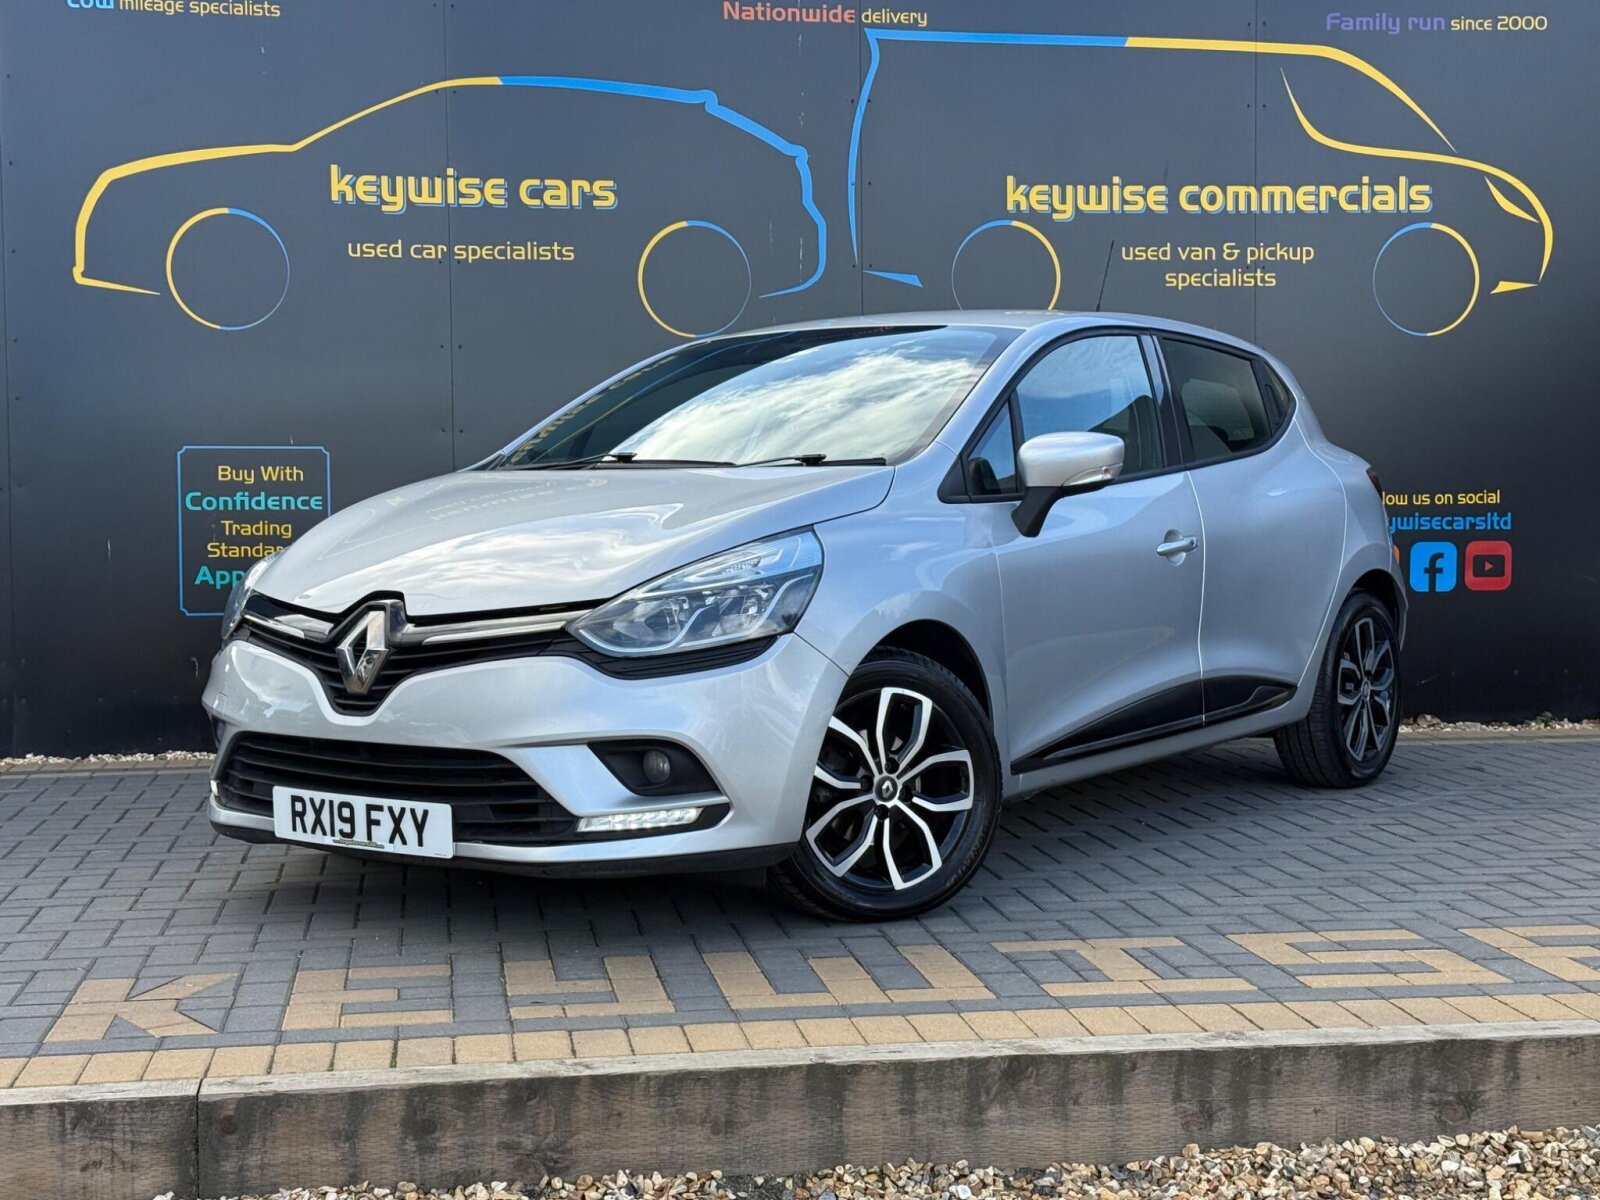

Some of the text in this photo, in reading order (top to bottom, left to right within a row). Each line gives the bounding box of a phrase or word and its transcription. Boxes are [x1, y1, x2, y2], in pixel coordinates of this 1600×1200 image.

[119, 0, 185, 16] mileage
[189, 0, 281, 17] specialists
[722, 1, 928, 27] Nationwide delivery
[1326, 12, 1548, 35] Family run since 2000
[330, 163, 618, 215] keywise cars
[1006, 175, 1433, 223] keywise commercials
[347, 239, 575, 264] used car specialists
[1121, 241, 1315, 265] used van & pickup
[1164, 268, 1277, 290] specialists
[217, 465, 304, 485] Buy With
[185, 491, 323, 511] Confidence
[1382, 489, 1501, 505] low us on social
[220, 520, 292, 539] Trading
[1389, 511, 1512, 534] ywisecarsltd
[206, 542, 284, 558] Standar
[194, 565, 247, 590] App
[290, 794, 429, 847] RX19 FXY
